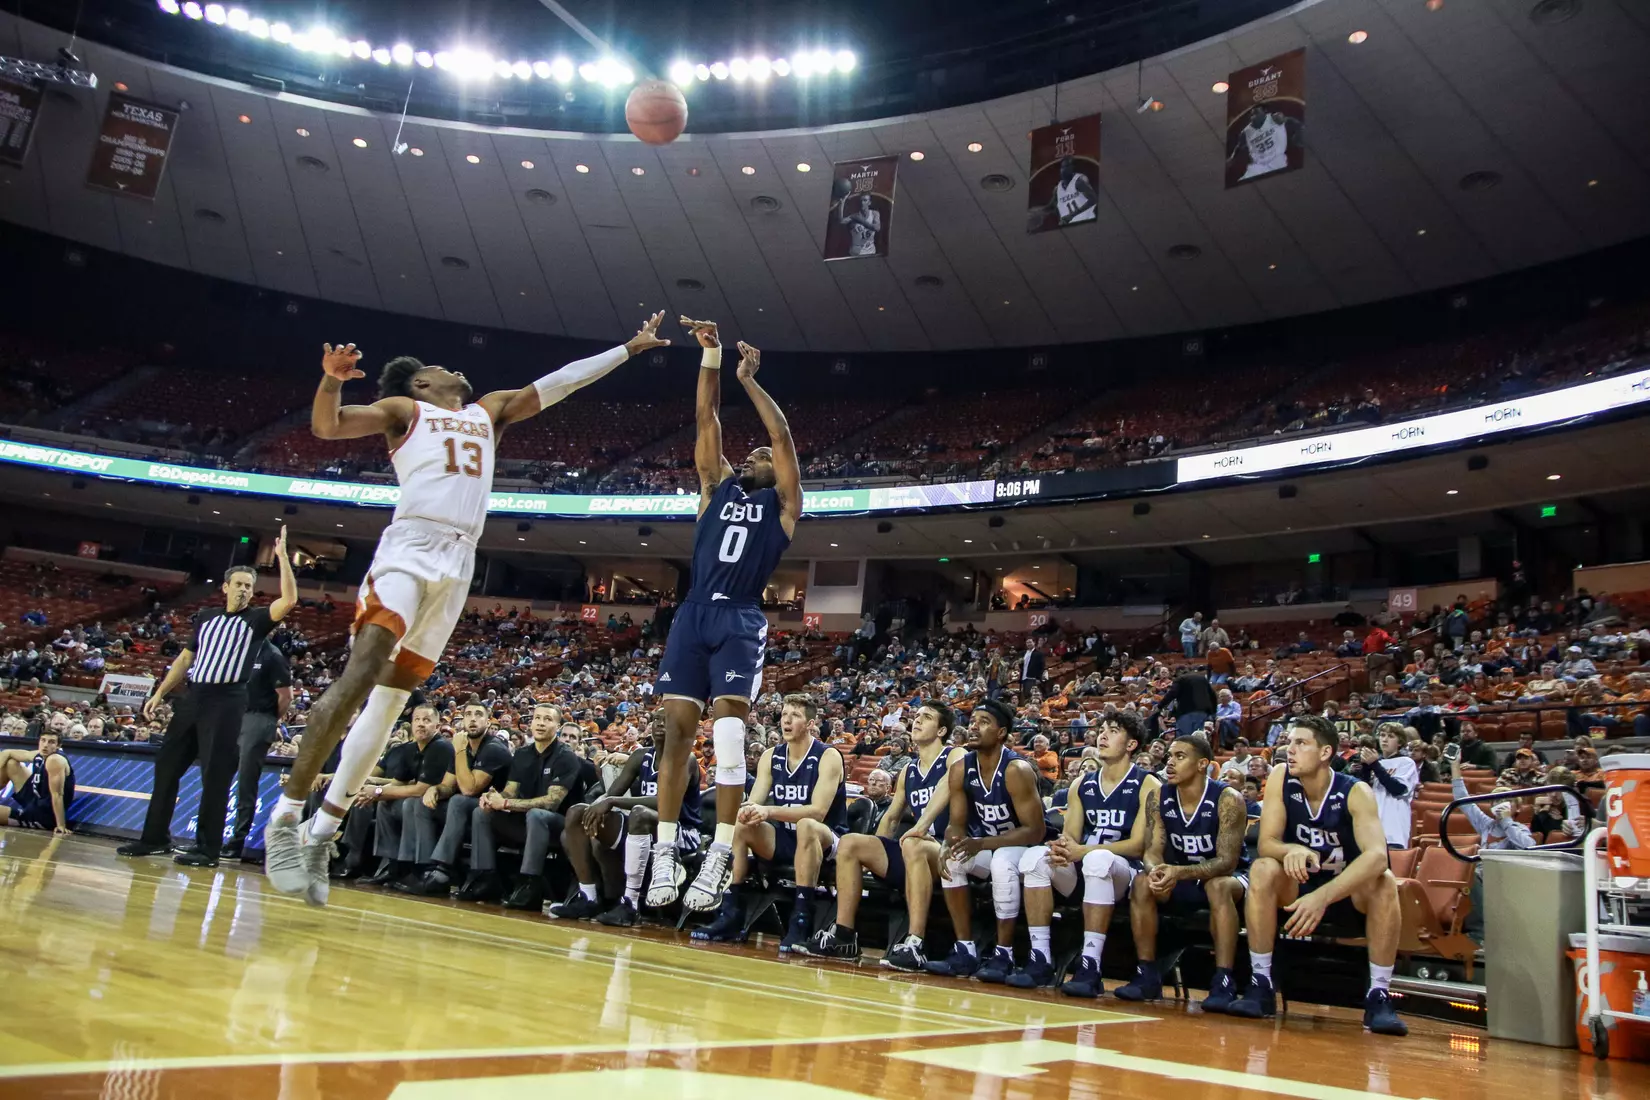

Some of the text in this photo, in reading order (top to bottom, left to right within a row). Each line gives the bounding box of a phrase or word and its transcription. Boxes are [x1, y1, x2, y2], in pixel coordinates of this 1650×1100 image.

[1248, 70, 1283, 88] DURANT
[1253, 81, 1278, 102] 35
[123, 103, 164, 122] TEXAS
[1056, 134, 1075, 144] FORD
[1256, 137, 1275, 154] 35
[1055, 140, 1075, 157] 11
[850, 170, 879, 180] MARTIN
[854, 178, 874, 192] 15
[1066, 199, 1078, 213] 11
[1484, 407, 1522, 423] HORN
[426, 418, 489, 440] TEXAS
[1391, 426, 1425, 441] HORN
[1301, 441, 1332, 455] HORN
[57, 452, 113, 471] DEPOT
[443, 437, 483, 479] 13
[1213, 456, 1243, 469] HORN
[148, 464, 249, 487] EQDepot.com
[288, 480, 362, 498] EQUIPMENT
[996, 479, 1041, 498] 8:06 PM
[588, 497, 663, 511] EQUIPMENT
[719, 501, 763, 522] CBU
[82, 544, 96, 556] 24
[718, 525, 748, 564] 0
[1392, 593, 1412, 607] 49
[583, 608, 597, 619] 22
[806, 616, 819, 627] 21
[1030, 614, 1046, 626] 20
[120, 689, 147, 697] NETWORK
[121, 682, 151, 692] LONGHORN
[640, 780, 658, 797] CB
[774, 784, 809, 801] CBU
[1606, 786, 1624, 817] G
[974, 801, 1010, 822] CBU
[1086, 809, 1126, 827] CBU
[1170, 833, 1213, 854] CBU
[1296, 823, 1340, 848] CBU
